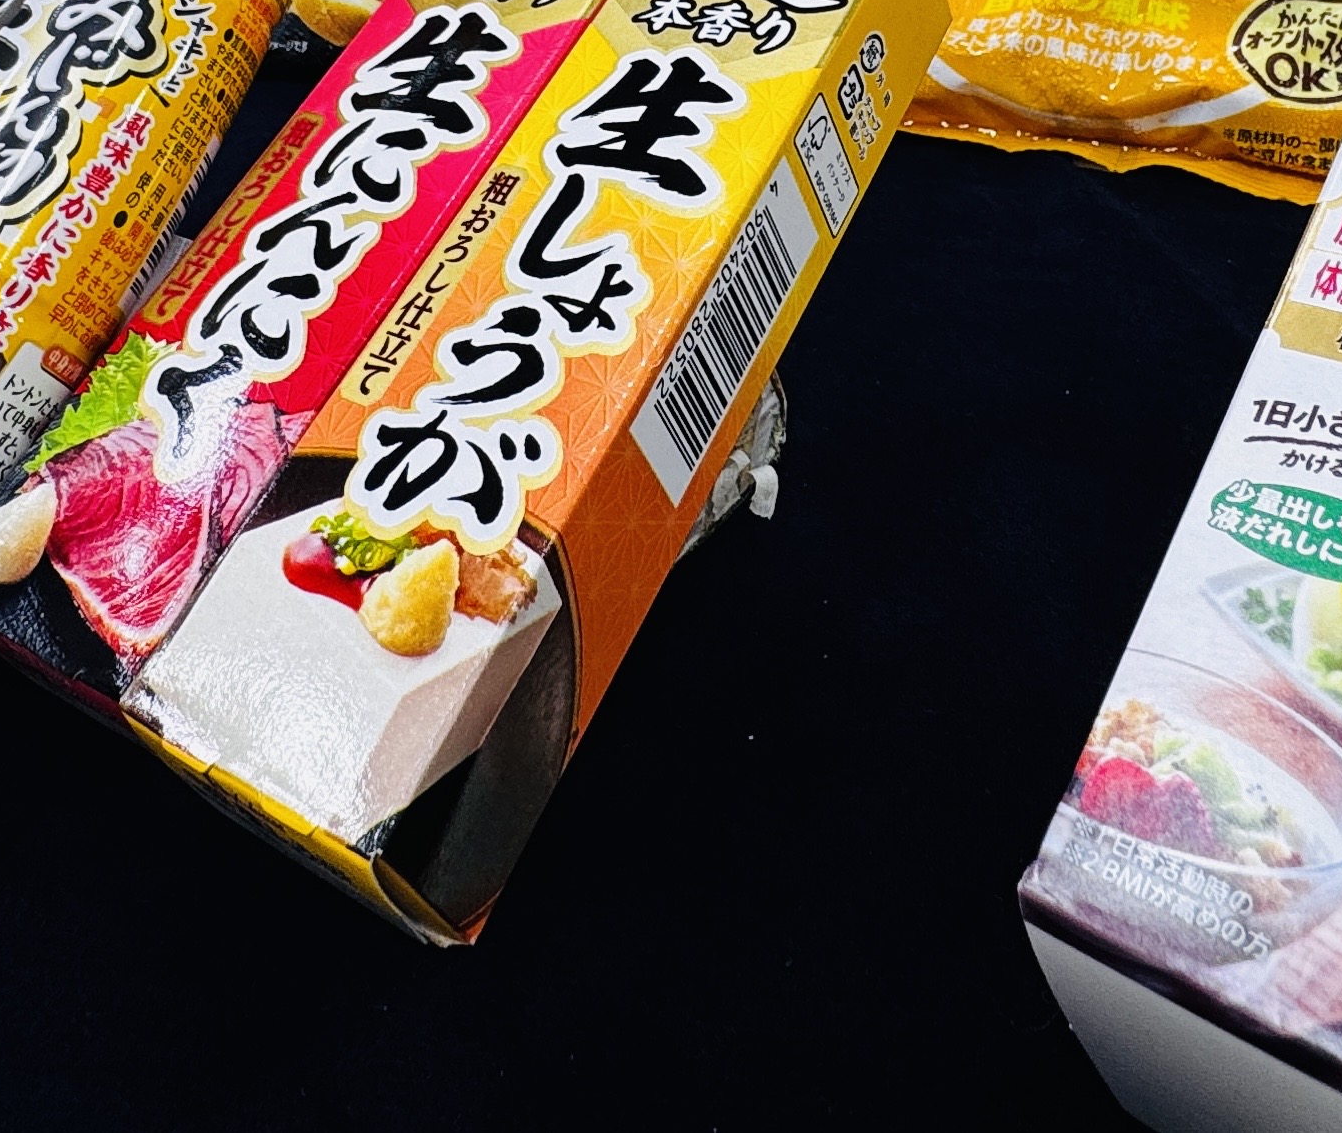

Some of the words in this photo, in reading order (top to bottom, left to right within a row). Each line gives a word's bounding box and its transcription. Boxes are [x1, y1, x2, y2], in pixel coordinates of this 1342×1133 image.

[153, 119, 319, 318] 粗おろし仕立て
[156, 11, 508, 459] 生にんにく
[361, 172, 522, 400] 粗おろし仕立て
[363, 55, 733, 523] 生しょうが
[654, 302, 713, 401] 280522
